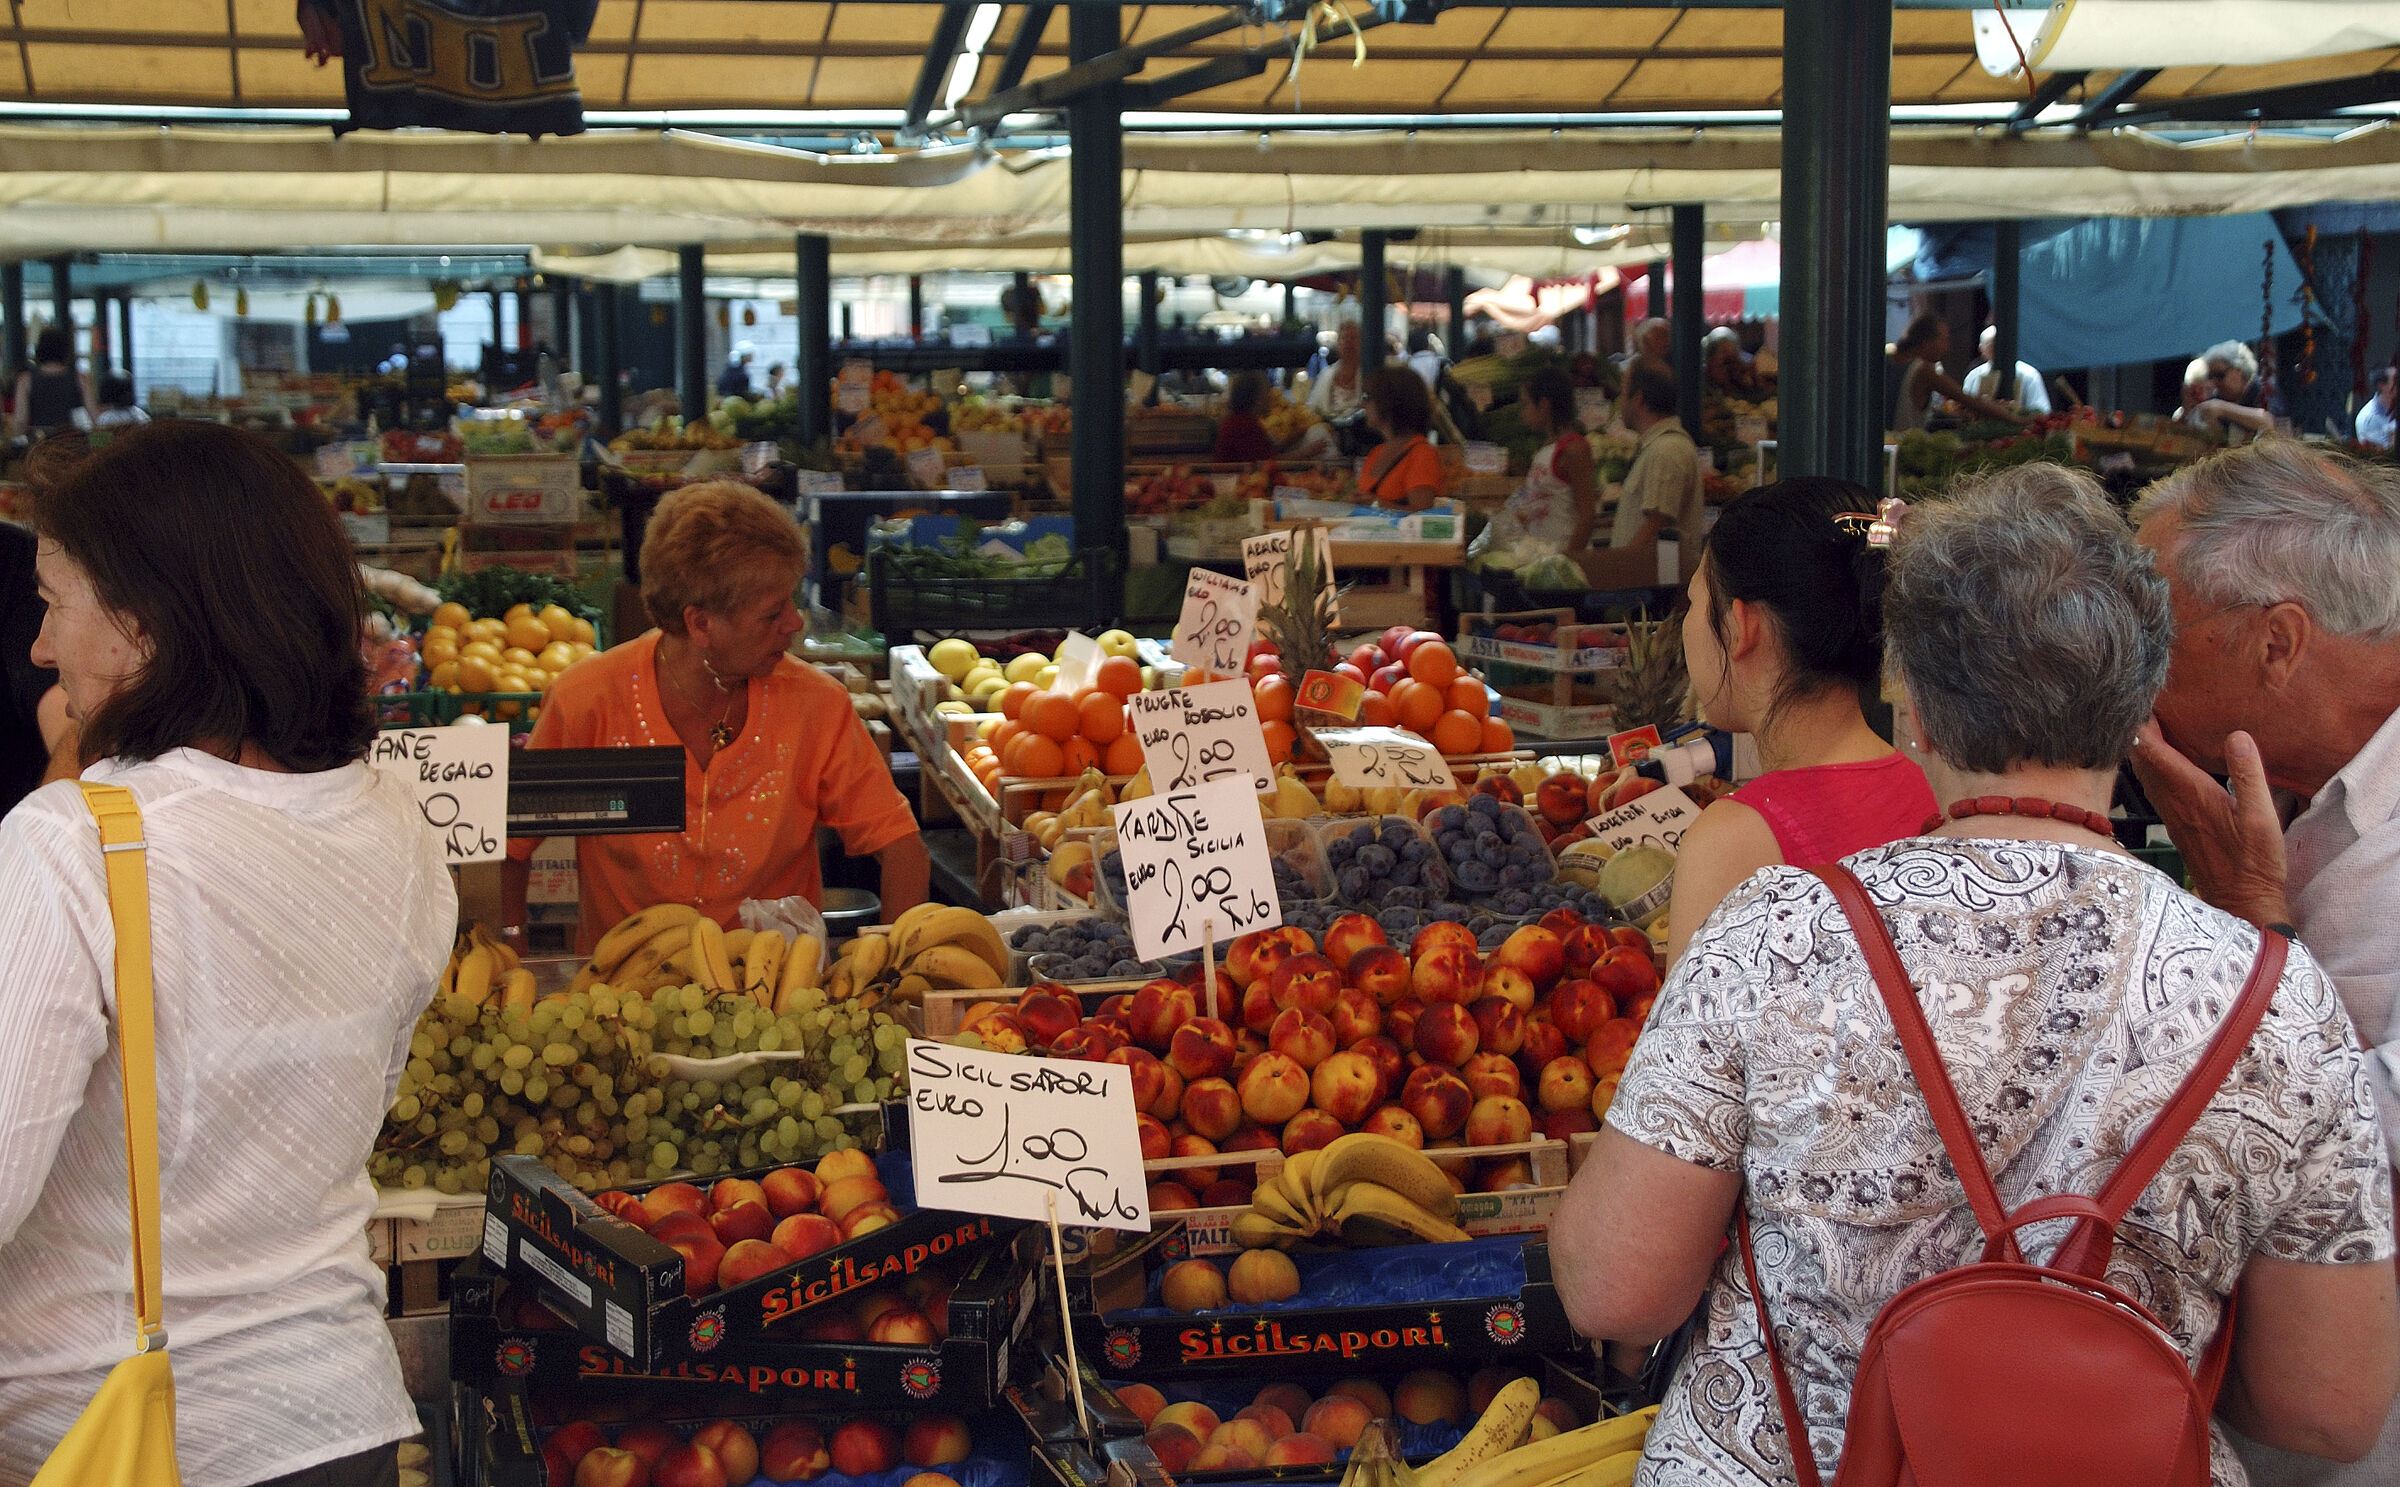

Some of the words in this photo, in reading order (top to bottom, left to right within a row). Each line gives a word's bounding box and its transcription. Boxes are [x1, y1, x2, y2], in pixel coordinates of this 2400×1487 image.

[419, 760, 494, 783] REGALO
[1186, 832, 1244, 859] SICILIA
[1161, 858, 1232, 944] 2.00
[910, 1046, 1003, 1088] SICIL
[1010, 1067, 1108, 1098] SAPORI
[915, 1088, 984, 1118] EURO
[1189, 1227, 1238, 1246] TALT
[761, 1217, 990, 1325] Sicilsapori
[1178, 1316, 1445, 1360] Sicilsapori
